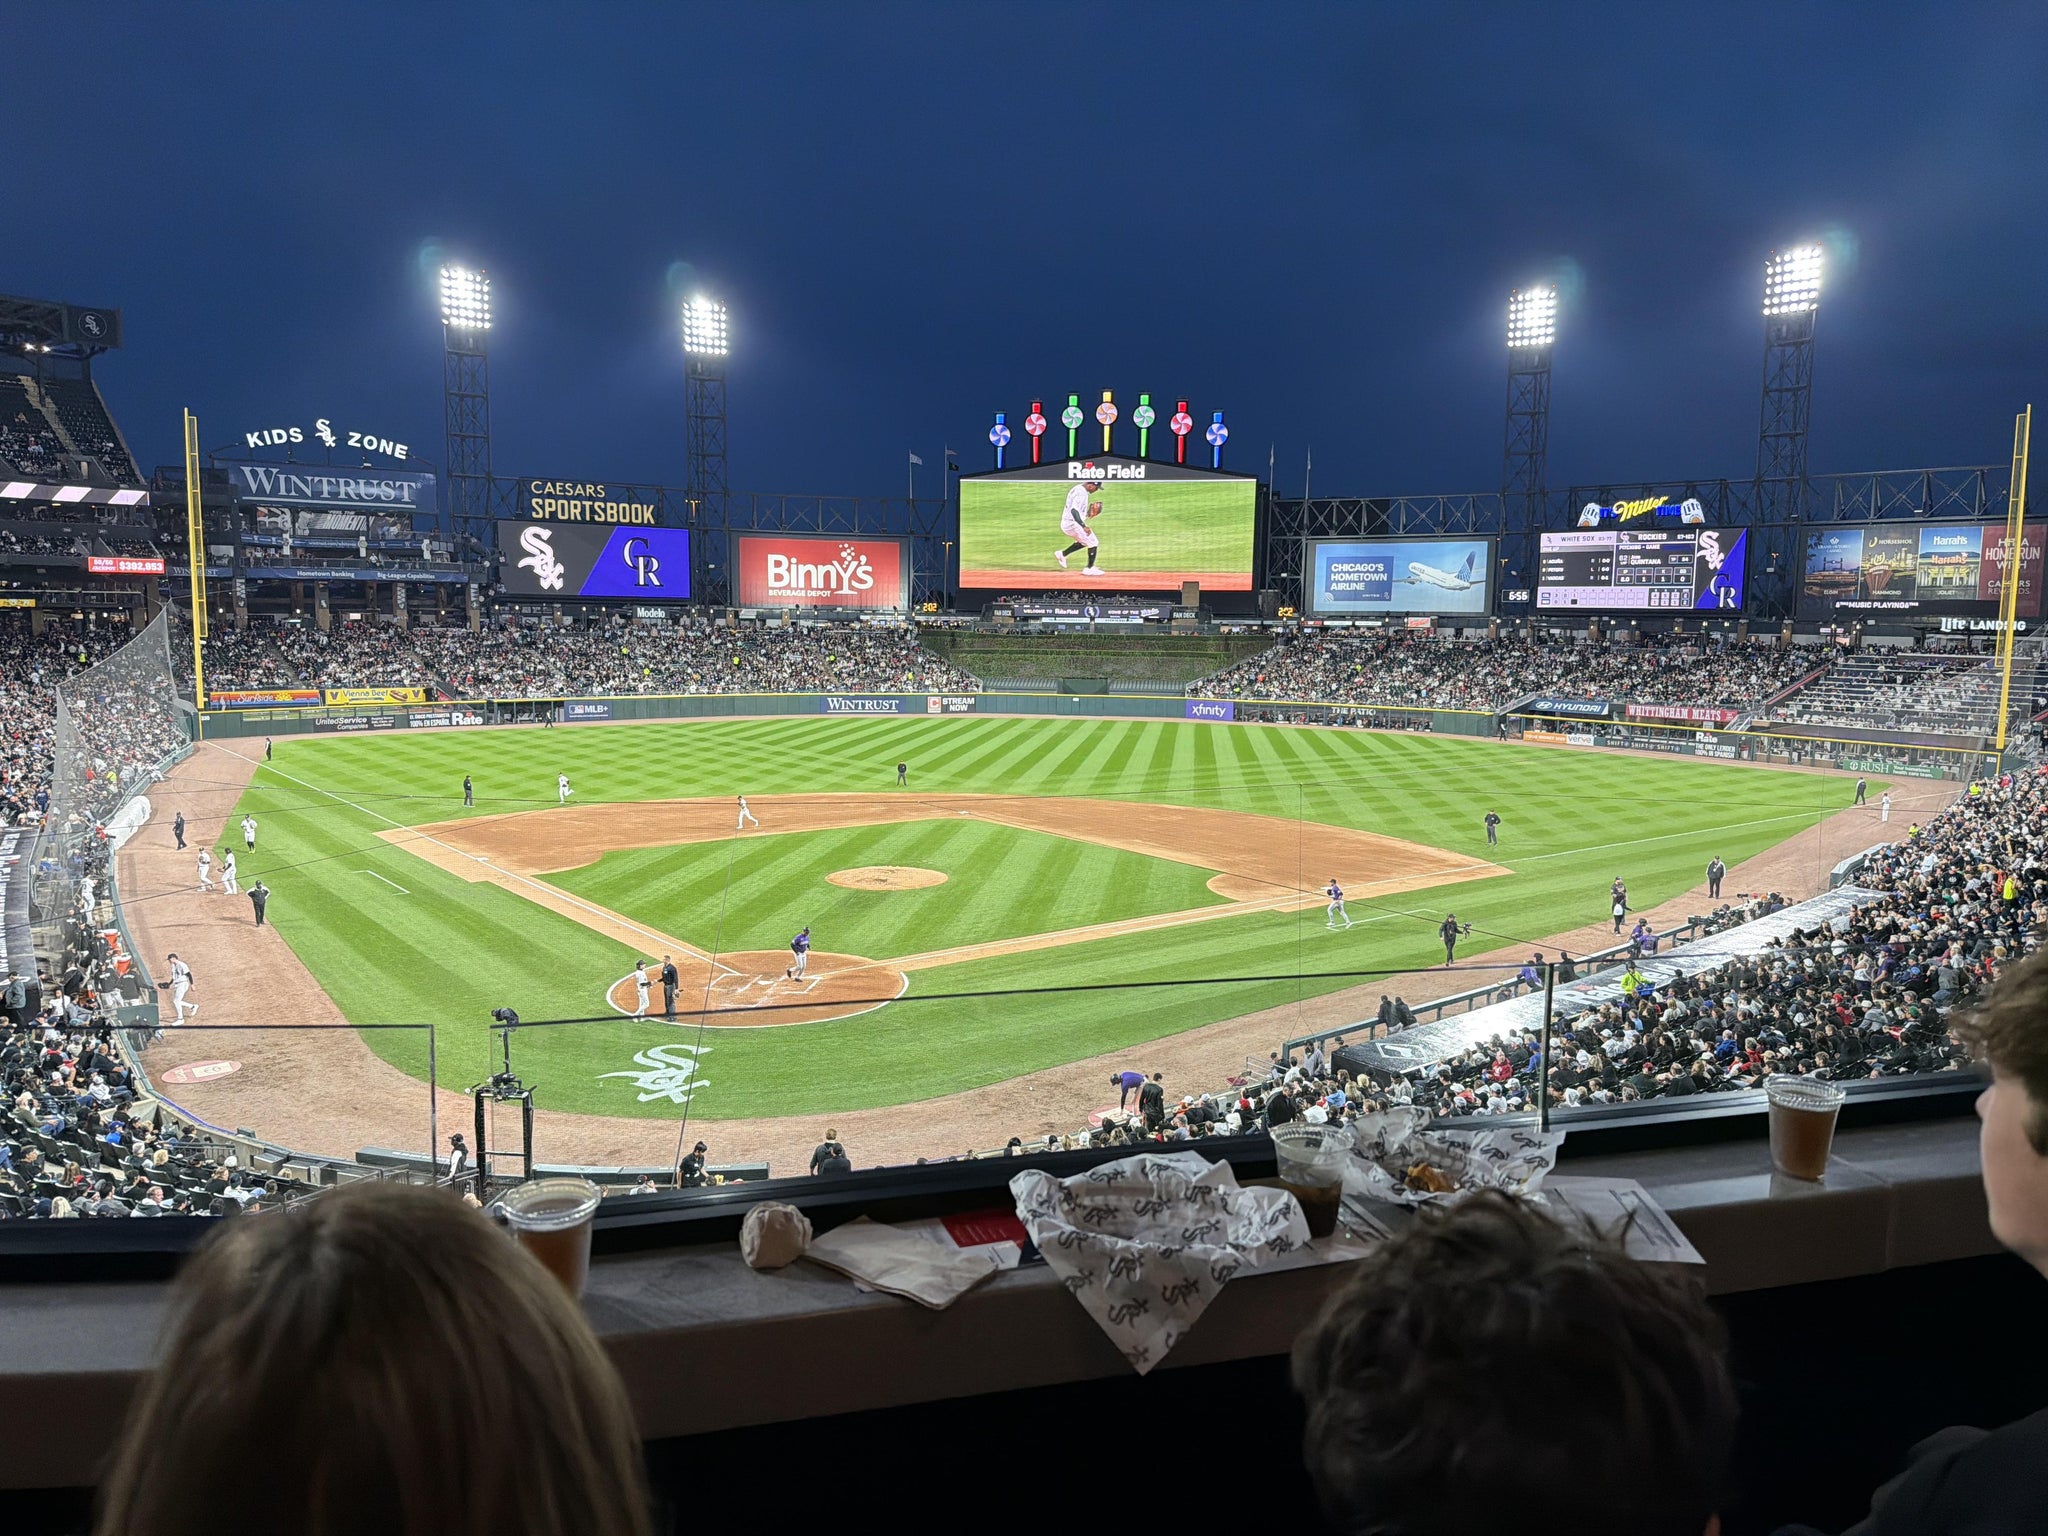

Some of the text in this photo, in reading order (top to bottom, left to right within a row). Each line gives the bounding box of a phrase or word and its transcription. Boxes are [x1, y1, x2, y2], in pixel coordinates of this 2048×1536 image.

[246, 427, 304, 448] KIDS
[347, 431, 408, 459] ZONE
[1068, 462, 1146, 479] Rate Field
[531, 481, 605, 498] CAESARS
[531, 498, 655, 524] SPORTSBOOK
[1584, 506, 1599, 519] Lite
[1613, 496, 1669, 522] Miller
[1656, 504, 1681, 516] TIME
[1683, 501, 1700, 516] Lite
[1637, 533, 1667, 541] ROCKIES
[2021, 537, 2029, 547] A
[2020, 546, 2041, 560] RUN
[622, 537, 664, 588] CR
[1331, 563, 1384, 573] CHICAGO'S
[331, 571, 355, 579] Banking
[767, 553, 874, 595] Binny's
[1330, 573, 1388, 582] HOMETOWN
[1330, 582, 1366, 591] AIRLINE
[768, 589, 831, 598] BEVERAGE DEPOT
[1508, 591, 1528, 601] 6:56
[637, 607, 666, 618] Modelo
[922, 602, 937, 612] 2:02
[1940, 617, 1967, 632] Lite
[237, 693, 274, 704] Surfside
[342, 689, 388, 698] Vienna Beef
[827, 697, 899, 710] WINTRUST
[942, 697, 975, 705] STREAM
[1192, 703, 1227, 717] xfinity
[1553, 702, 1602, 713] HYUNDAI
[1628, 705, 1688, 719] WHITTINGHAM
[1692, 709, 1721, 721] MEATS
[451, 712, 483, 726] Rate
[1568, 735, 1591, 743] verve
[1695, 731, 1718, 744] Rate
[1860, 763, 1889, 774] RUSH
